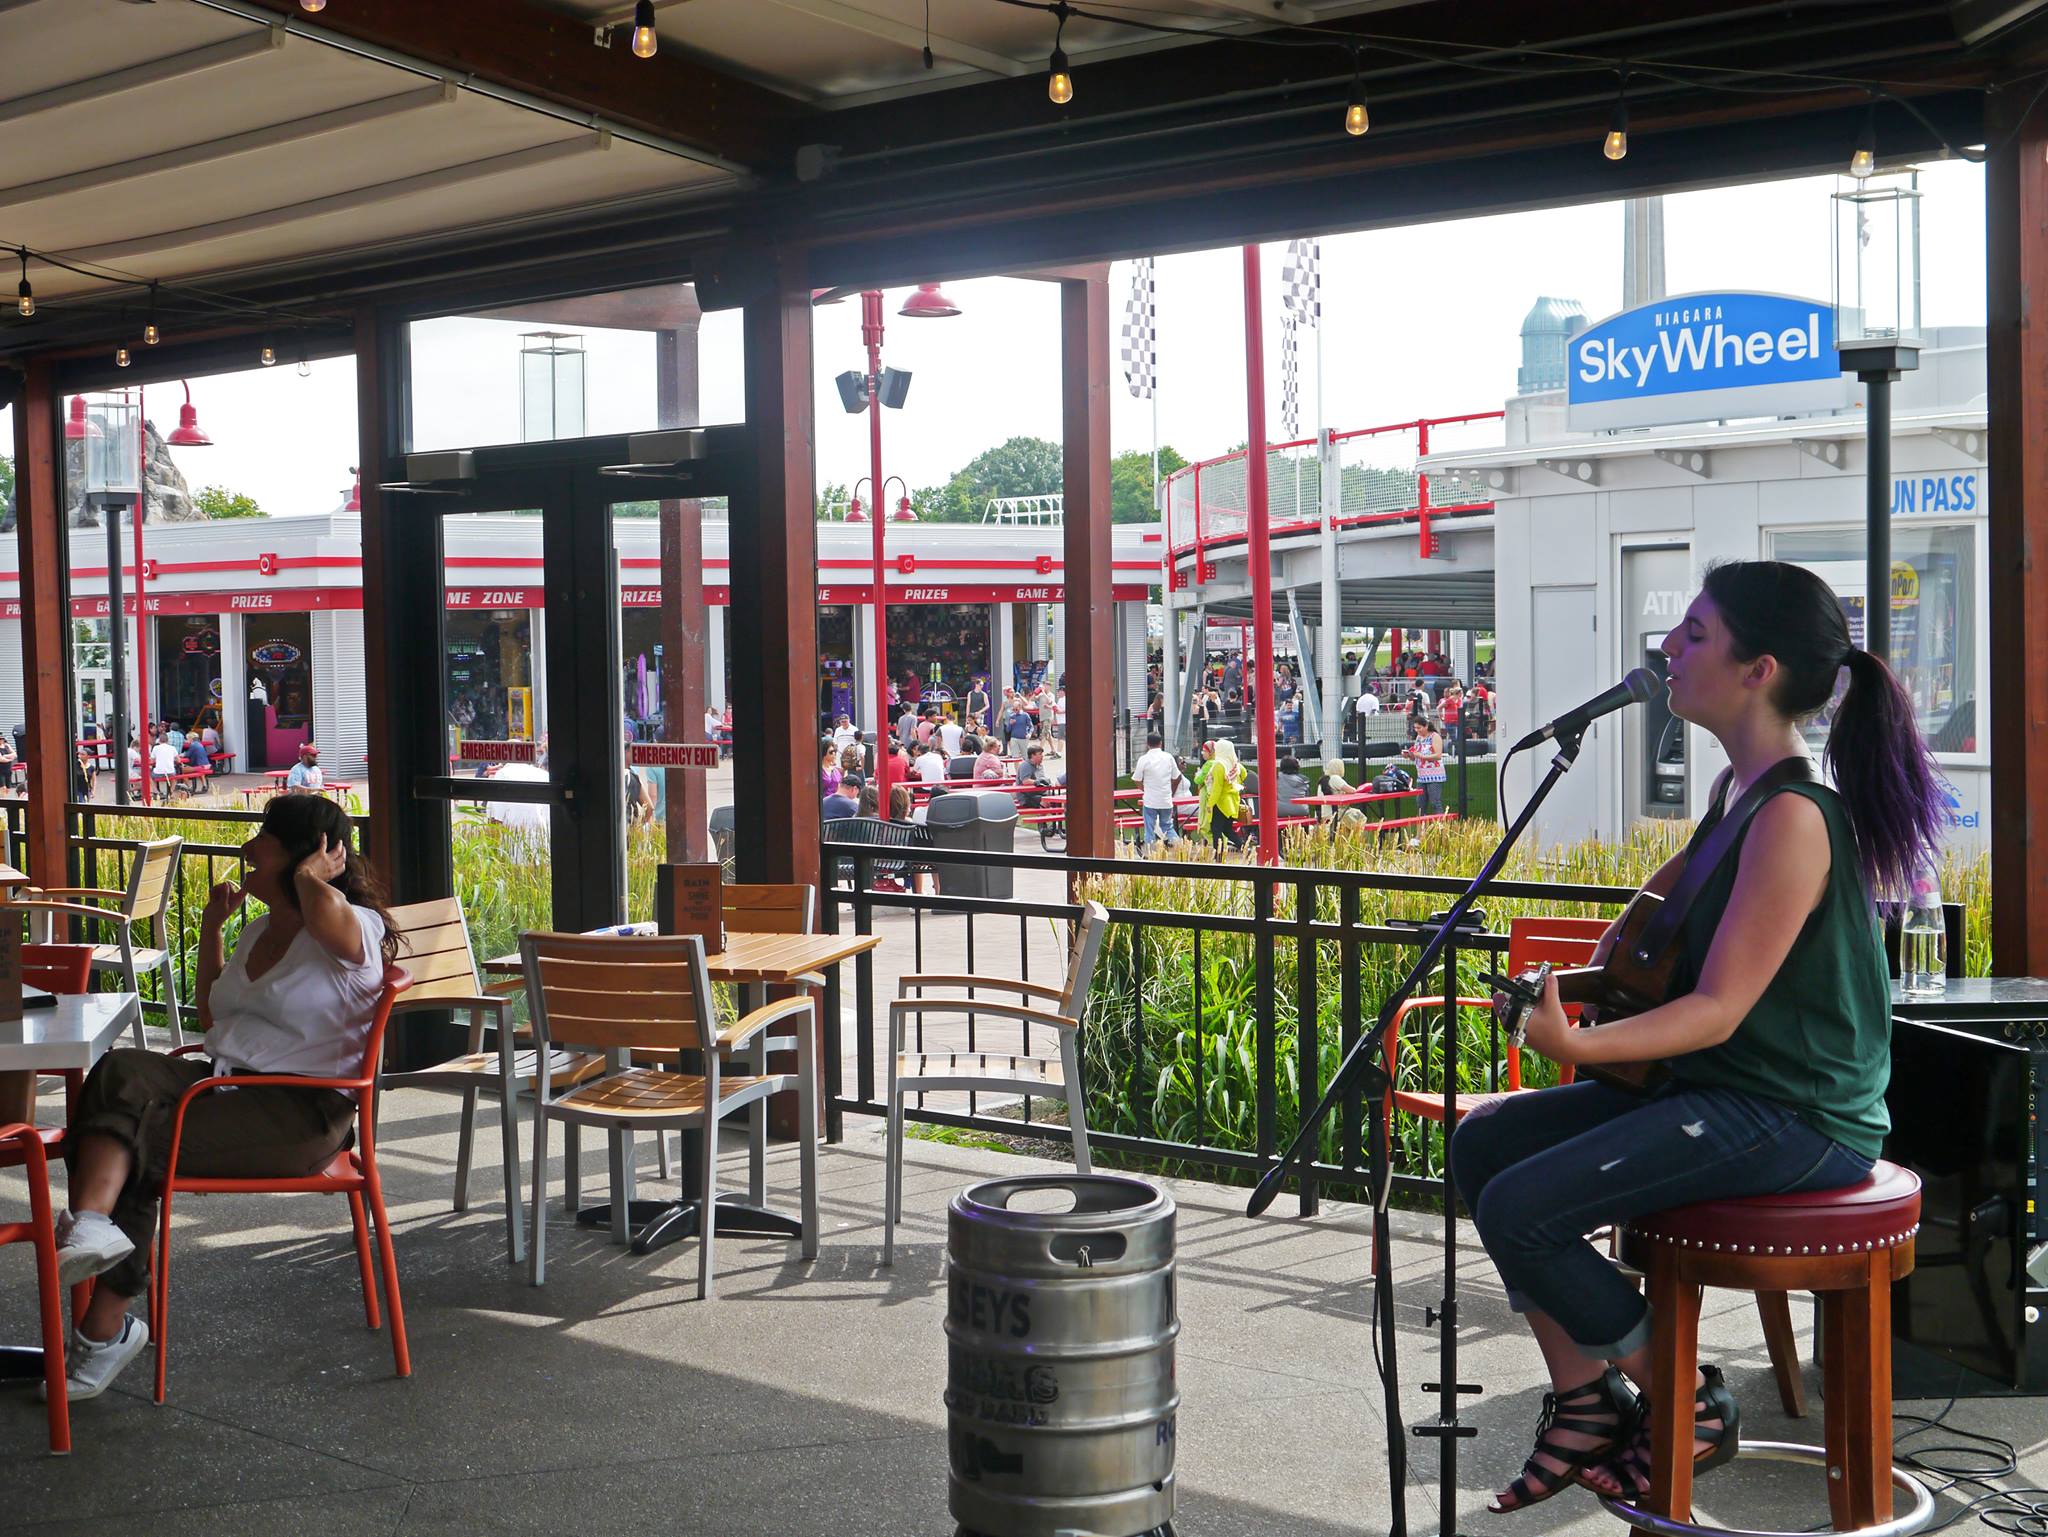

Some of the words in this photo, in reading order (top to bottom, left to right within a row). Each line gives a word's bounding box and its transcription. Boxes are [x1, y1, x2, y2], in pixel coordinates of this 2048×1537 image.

[1655, 306, 1723, 327] NIAGARA
[1579, 313, 1820, 388] SkyWheel
[1921, 475, 1976, 512] PASS
[231, 595, 273, 608] PRIZES
[481, 592, 524, 604] ZONE
[904, 589, 949, 600] PRIZES
[1016, 588, 1049, 599] GAME
[460, 743, 513, 761] EMERGENCY
[515, 744, 536, 762] EXIT
[632, 746, 692, 766] EMERGENCY
[694, 747, 717, 766] EXIT
